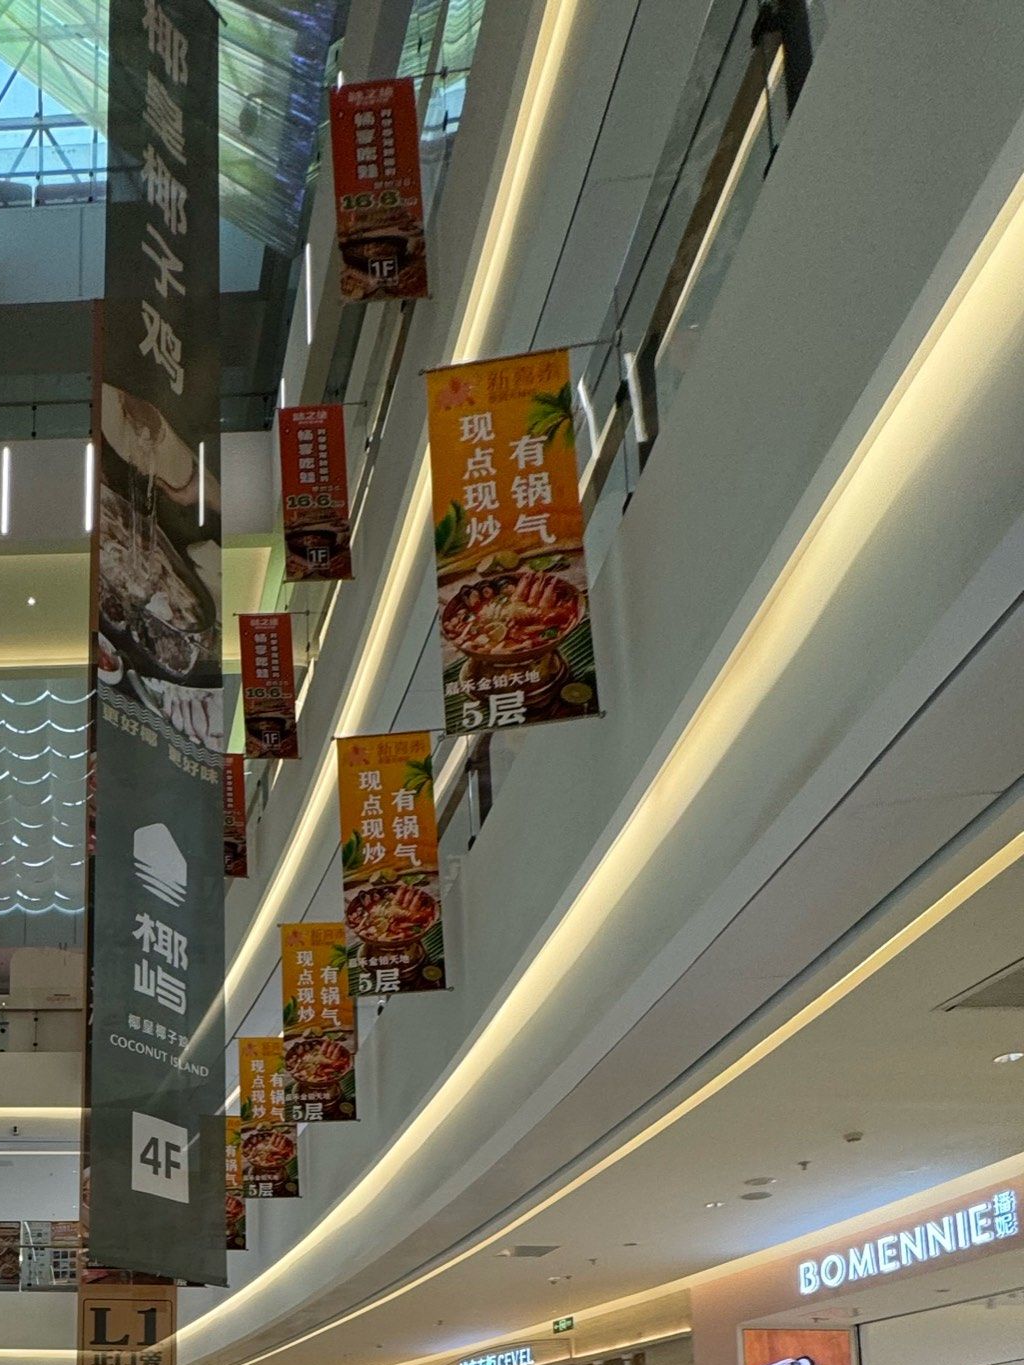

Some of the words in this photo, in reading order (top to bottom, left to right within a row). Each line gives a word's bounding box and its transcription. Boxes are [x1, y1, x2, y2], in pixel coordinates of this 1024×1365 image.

[371, 260, 394, 277] 1F
[459, 411, 501, 548] 现点现炒
[509, 434, 556, 544] 有锅气
[310, 550, 326, 563] 1F
[462, 690, 527, 729] 5层
[359, 771, 385, 865] 现点现炒
[392, 789, 421, 866] 有锅气
[132, 912, 188, 1015] 椰屿
[296, 950, 316, 1023] 现点现炒
[358, 968, 401, 993] 5层
[321, 966, 341, 1027] 有锅气
[109, 1033, 167, 1063] COCONUT
[170, 1055, 209, 1077] ISLAND
[250, 1059, 266, 1119] 现点现炒
[270, 1073, 285, 1121] 有锅气
[292, 1102, 324, 1121] 5层
[139, 1136, 182, 1180] 4F
[248, 1182, 274, 1197] 5层
[798, 1202, 994, 1295] BOMENNIE
[90, 1307, 157, 1345] L1
